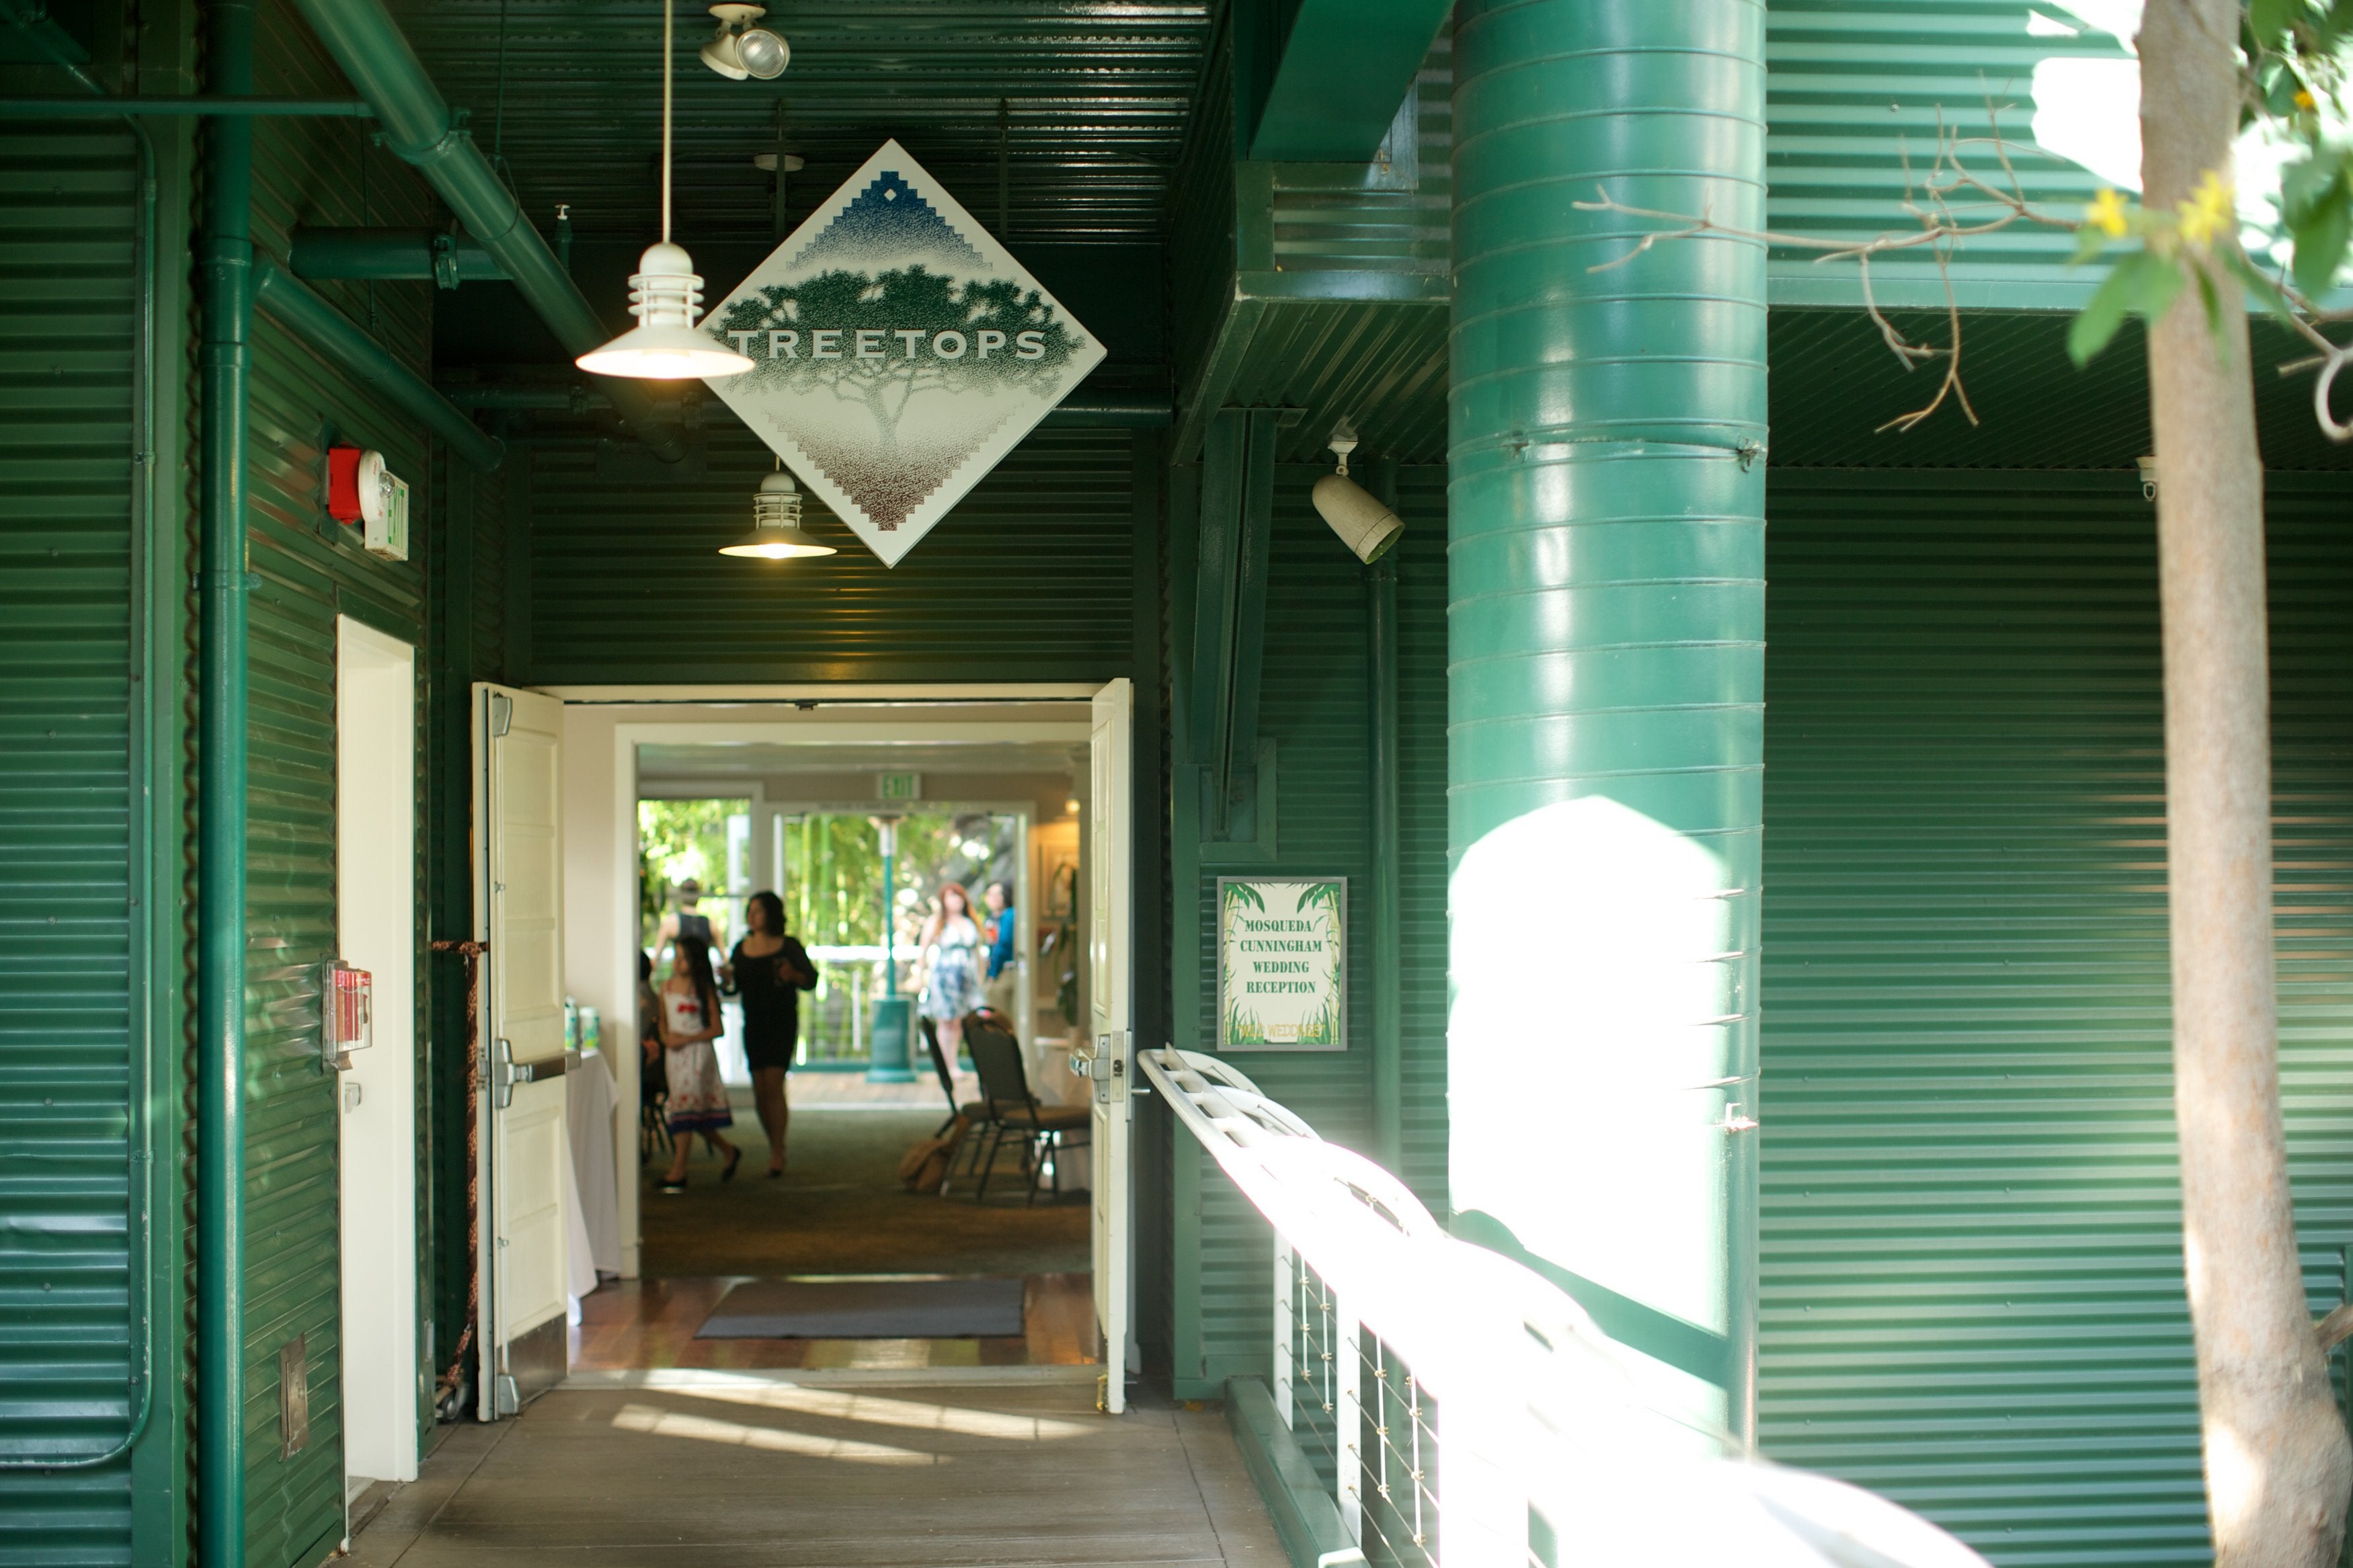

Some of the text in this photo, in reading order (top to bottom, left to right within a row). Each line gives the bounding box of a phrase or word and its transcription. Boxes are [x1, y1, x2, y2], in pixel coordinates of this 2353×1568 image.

[727, 328, 1047, 360] TREETOPS
[882, 774, 913, 798] EXIT
[1245, 919, 1318, 932] MOSQUEDA/
[1240, 940, 1322, 952] CUNNINGHAM
[1253, 962, 1309, 973] WEDDING
[1246, 982, 1316, 993] RECEPTION
